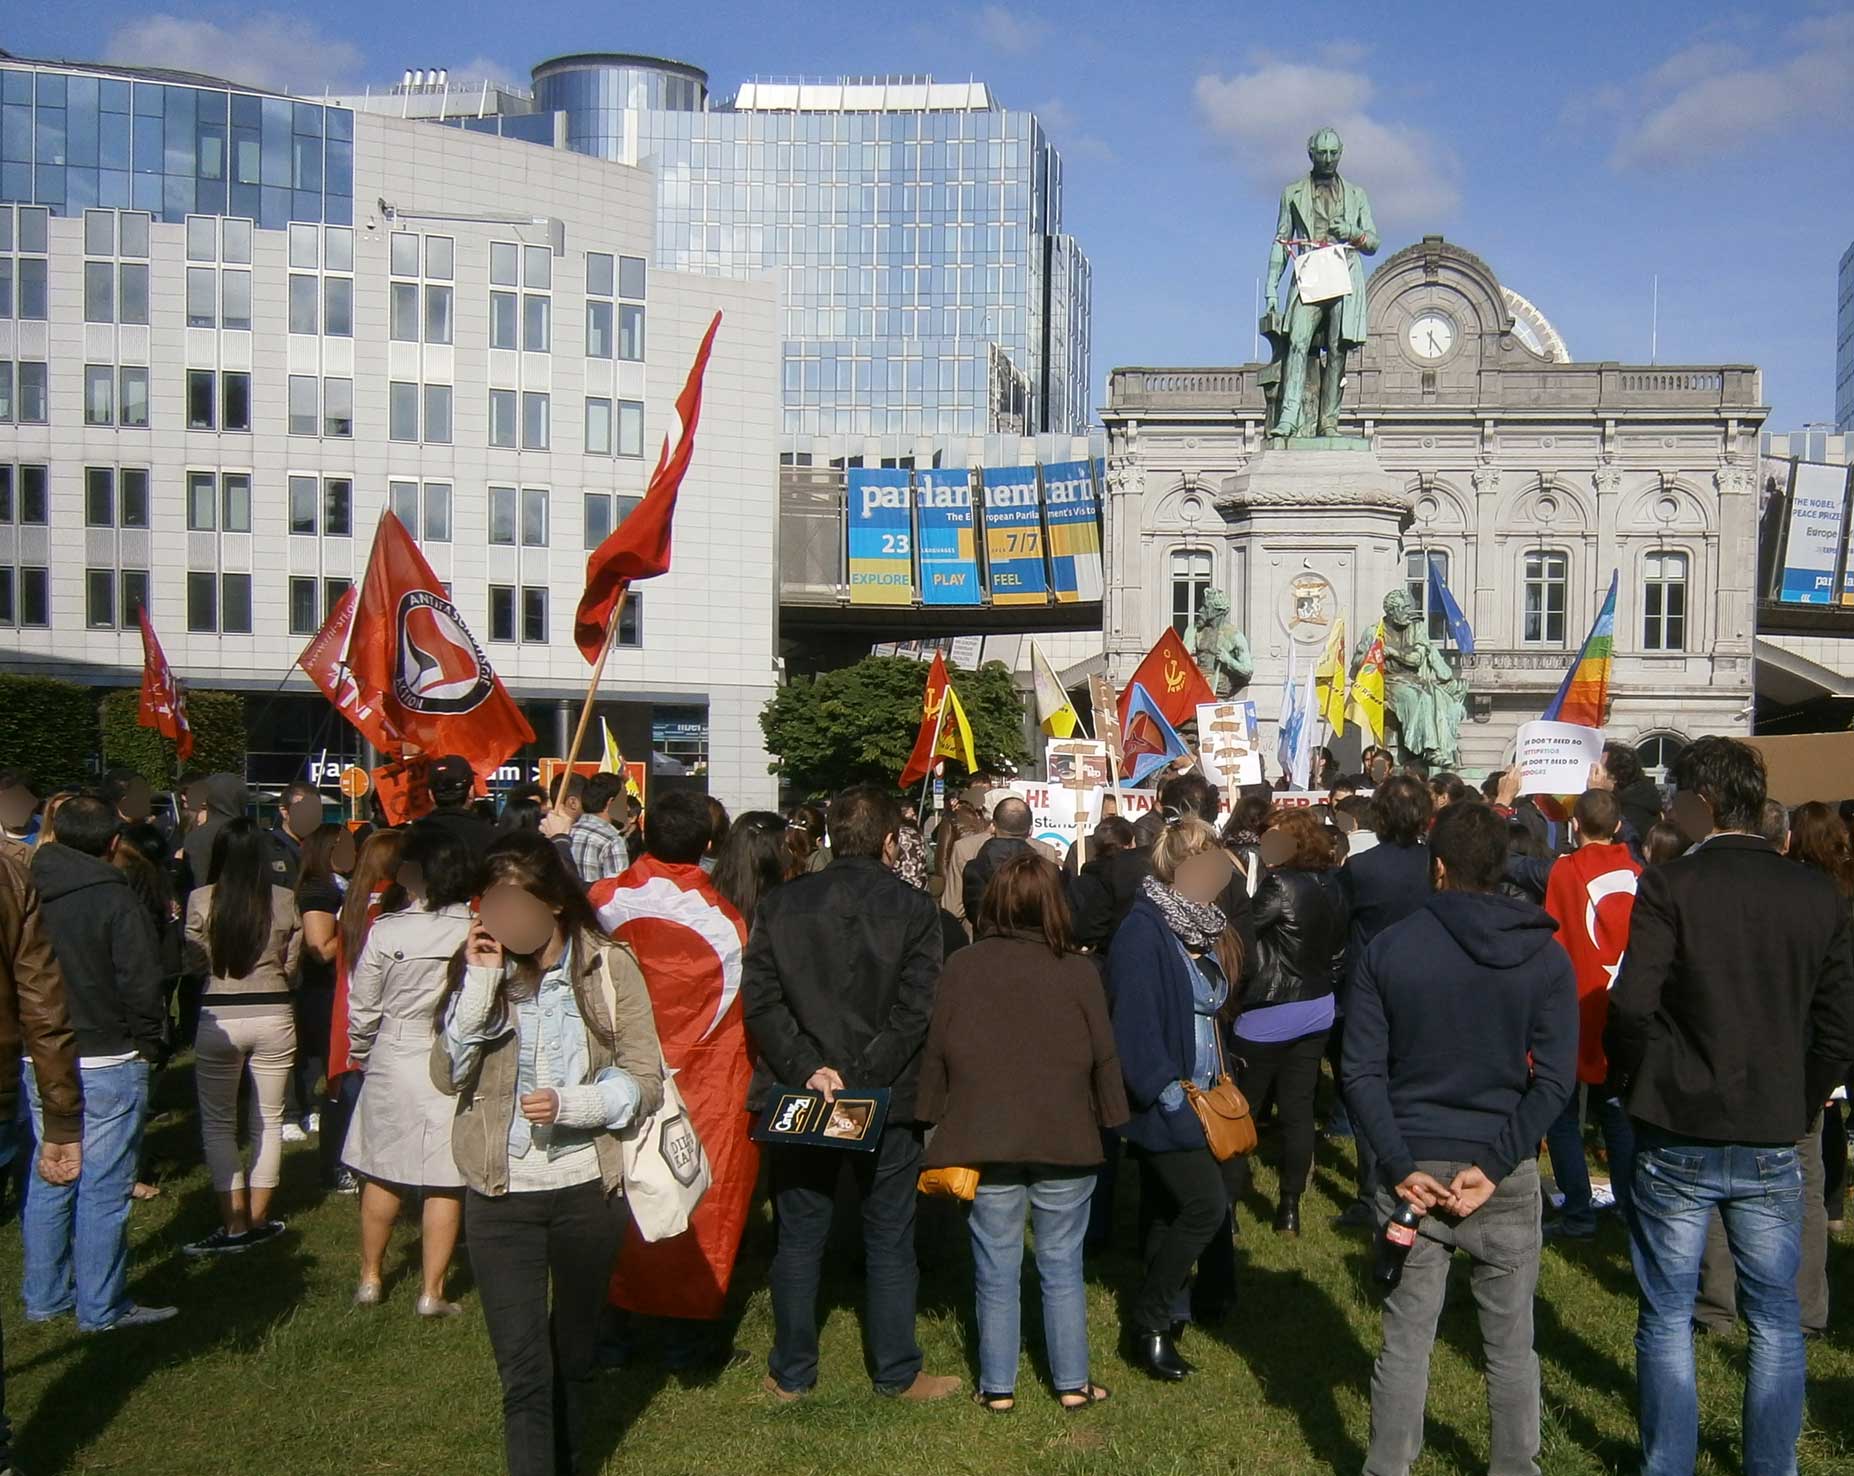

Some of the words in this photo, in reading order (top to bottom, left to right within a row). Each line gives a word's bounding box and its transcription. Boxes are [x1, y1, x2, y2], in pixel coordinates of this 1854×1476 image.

[1794, 498, 1809, 506] THE
[1810, 499, 1835, 509] NOBEL
[946, 512, 964, 521] The
[1793, 510, 1817, 518] PEACE
[1819, 511, 1842, 521] PRIZE
[1806, 526, 1837, 539] Europe
[881, 533, 909, 553] 23
[1006, 532, 1038, 553] 7/7
[851, 573, 909, 585] EXPLORE
[934, 574, 966, 586] PLAY
[994, 573, 1023, 586] FEEL
[1026, 790, 1049, 808] HE
